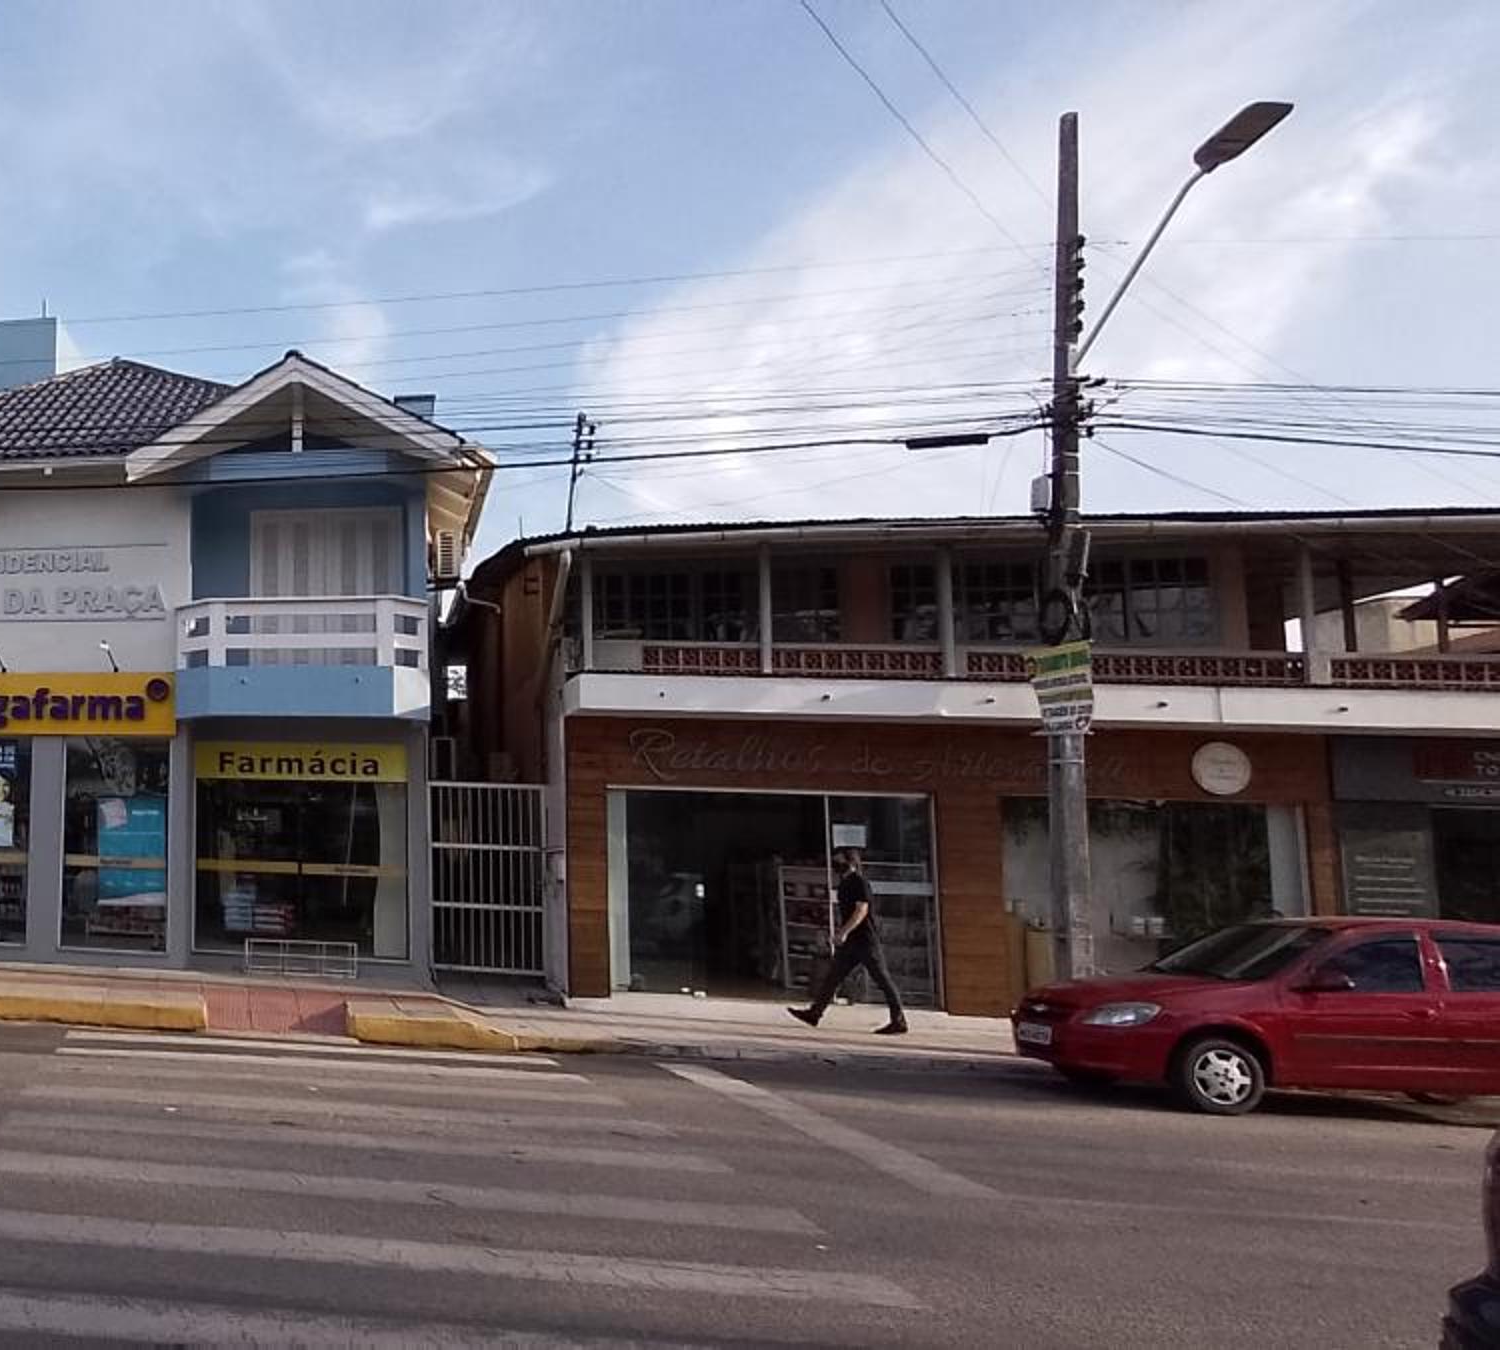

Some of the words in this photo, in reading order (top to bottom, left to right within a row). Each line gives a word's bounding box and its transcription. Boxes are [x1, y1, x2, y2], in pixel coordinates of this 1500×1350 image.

[3, 587, 47, 616] DA
[56, 584, 166, 618] PRAÇA
[218, 750, 380, 776] Farmácia
